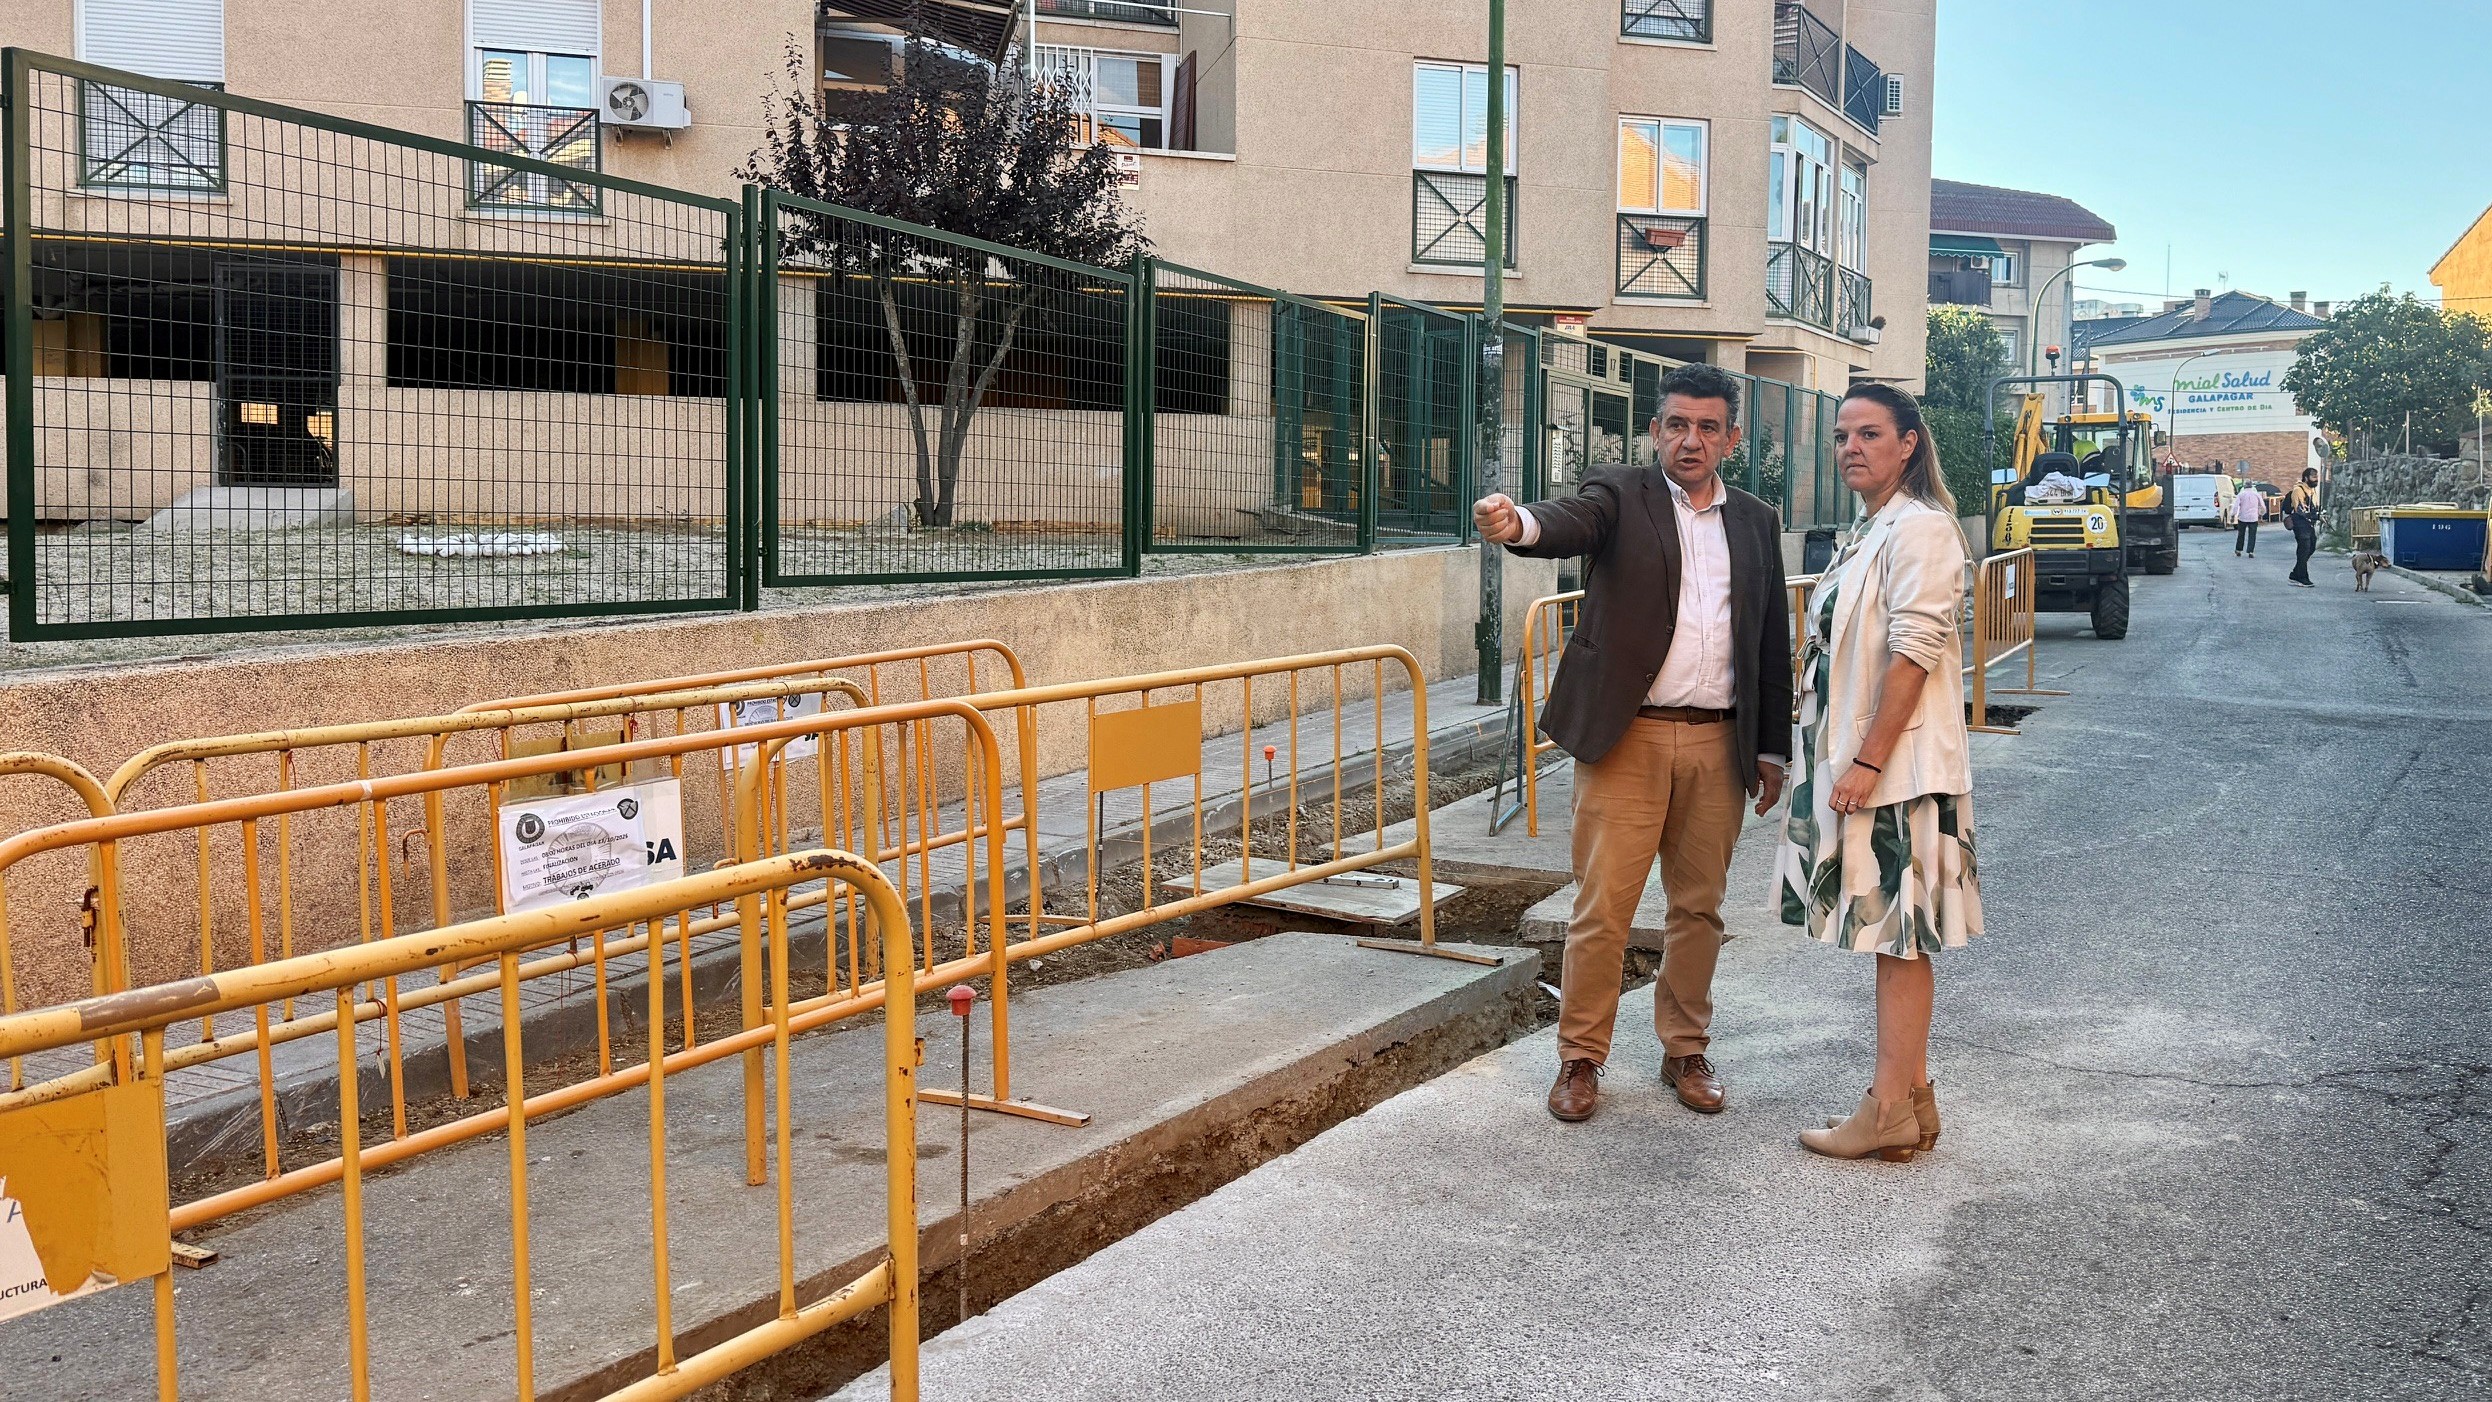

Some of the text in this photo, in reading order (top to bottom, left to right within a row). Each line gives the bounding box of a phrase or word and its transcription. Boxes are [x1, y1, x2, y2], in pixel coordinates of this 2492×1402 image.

[2221, 370, 2271, 388] Salud
[2188, 392, 2254, 403] GALAPAGAR
[547, 814, 580, 827] PROHIBIDO
[556, 843, 575, 853] HORAS
[576, 841, 586, 849] DEL
[543, 869, 577, 884] TRABAJOS
[578, 865, 588, 875] DE
[588, 857, 621, 871] ACERADO
